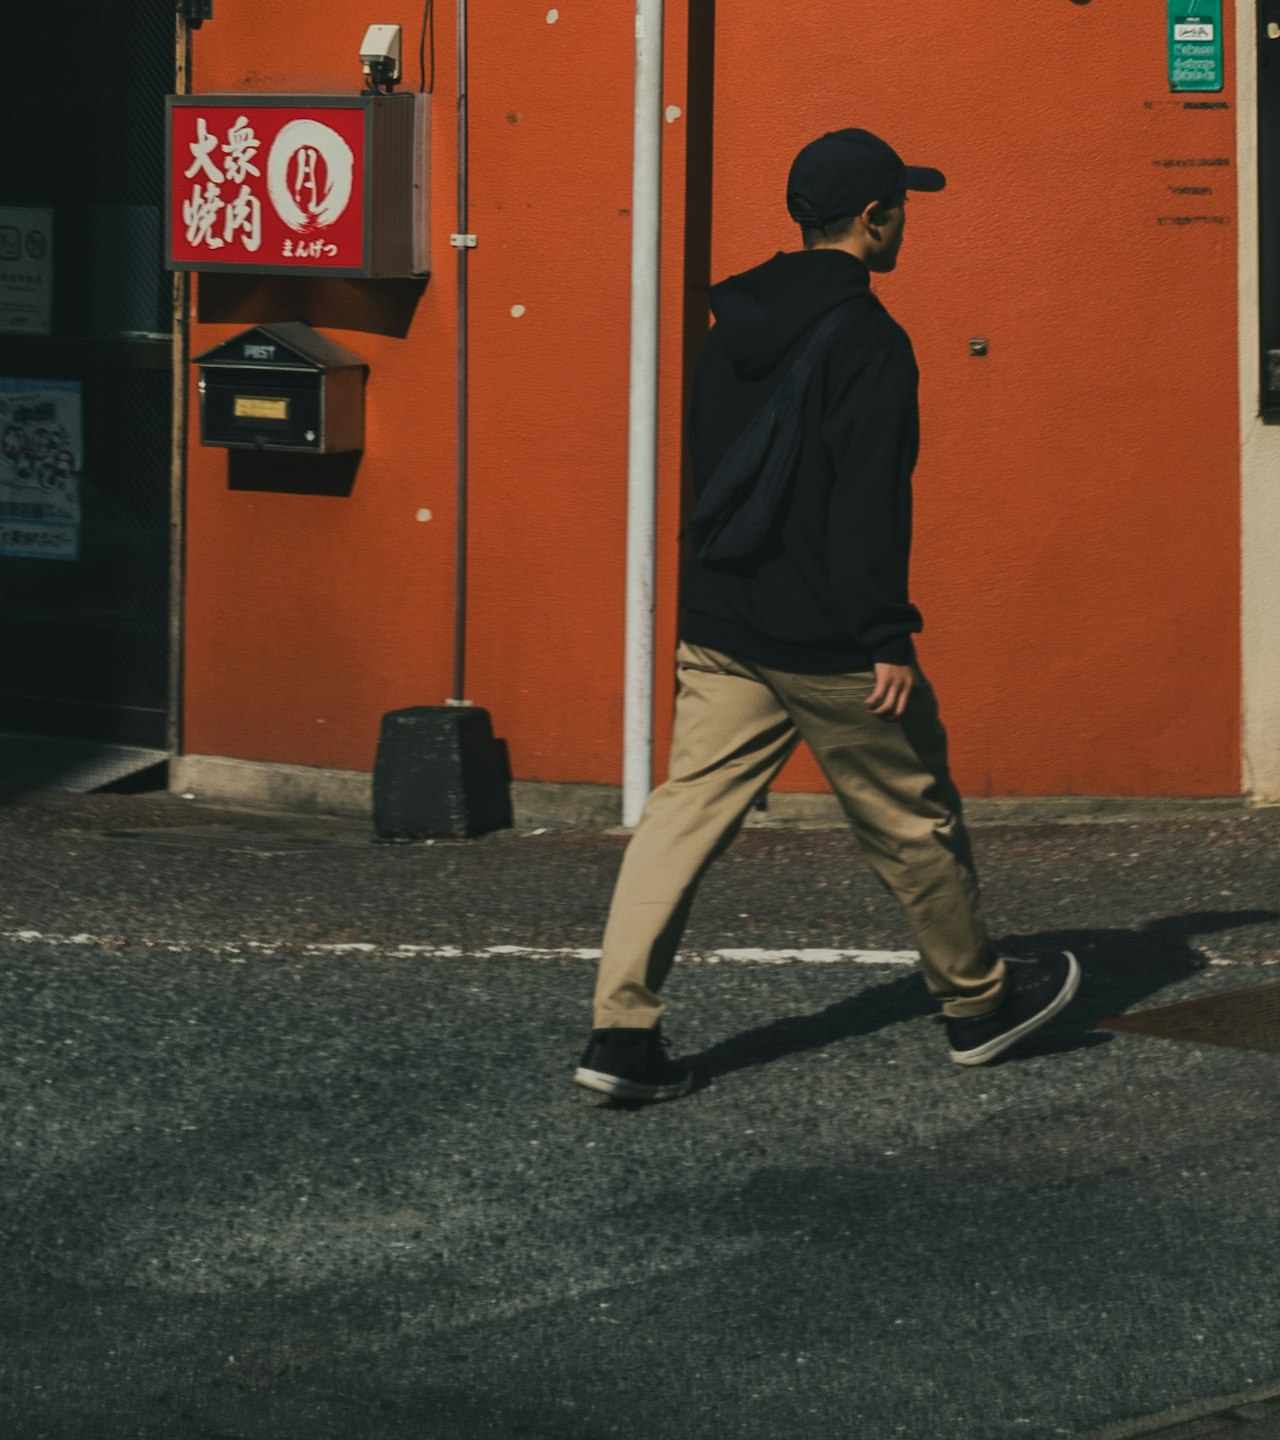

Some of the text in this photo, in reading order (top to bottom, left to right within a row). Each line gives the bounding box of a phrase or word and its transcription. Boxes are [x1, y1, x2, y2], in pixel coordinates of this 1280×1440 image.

[184, 115, 262, 184] 大衆
[182, 181, 262, 252] 焼肉
[281, 238, 338, 259] まんげつ
[244, 344, 276, 360] POST
